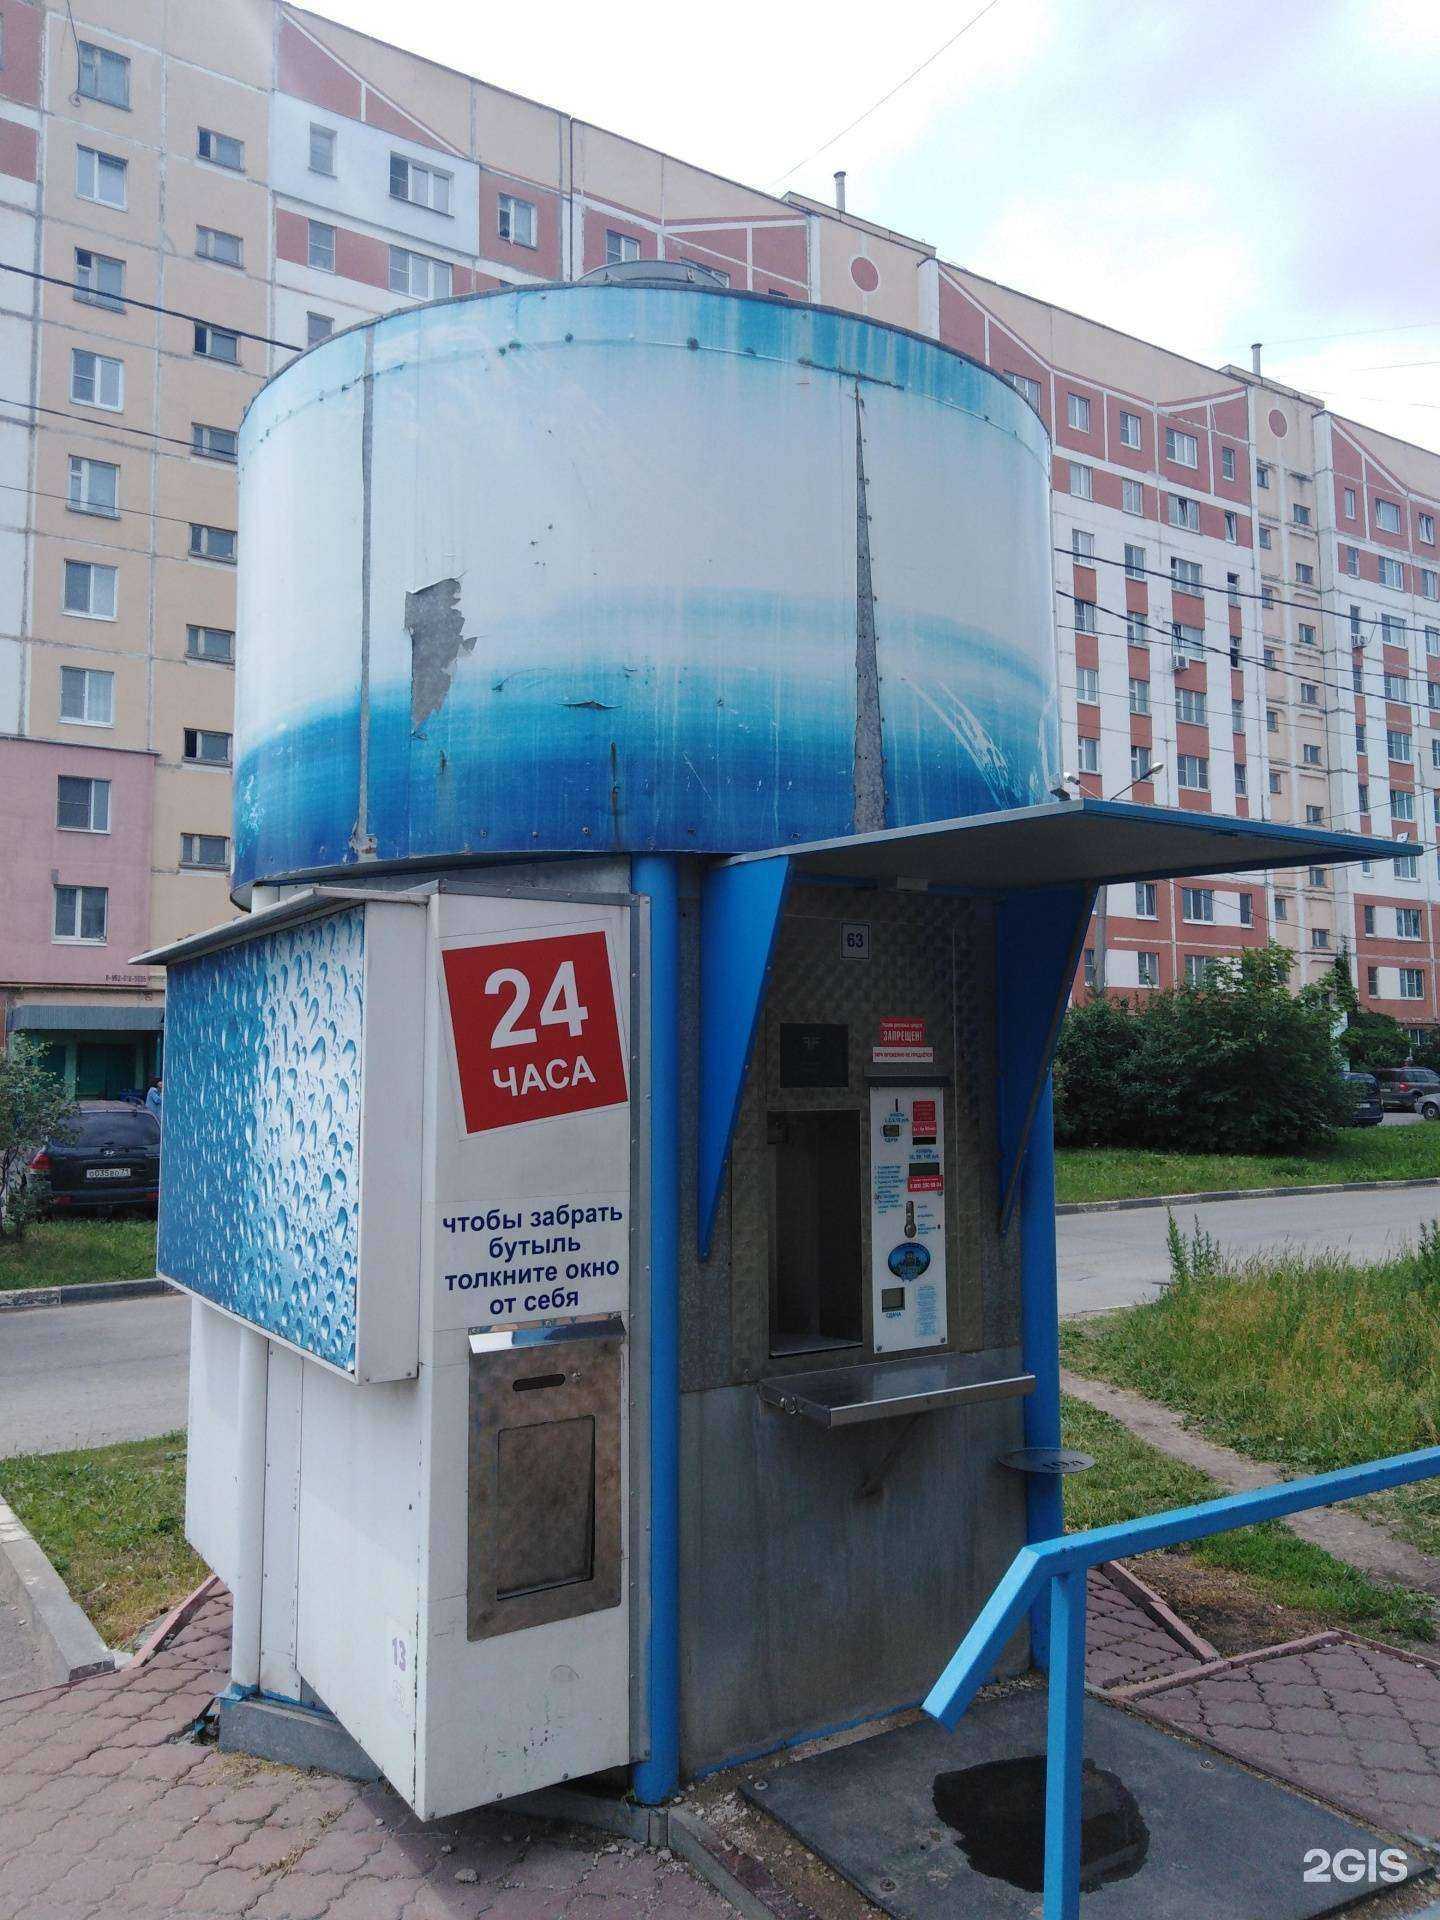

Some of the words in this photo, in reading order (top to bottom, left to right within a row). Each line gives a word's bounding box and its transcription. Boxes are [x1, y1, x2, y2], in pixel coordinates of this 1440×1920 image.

[847, 932, 864, 948] 63
[483, 960, 589, 1050] 24
[883, 1030, 922, 1043] ЗАПРЕЩЕН!
[492, 1055, 597, 1098] ЧАСА
[442, 1208, 522, 1233] чтобы
[530, 1202, 623, 1228] забрать
[489, 1235, 582, 1263] бутыль
[445, 1266, 558, 1291] толкните
[565, 1260, 620, 1281] окно
[489, 1297, 517, 1316] от
[523, 1288, 580, 1313] себя
[392, 1637, 407, 1672] 13
